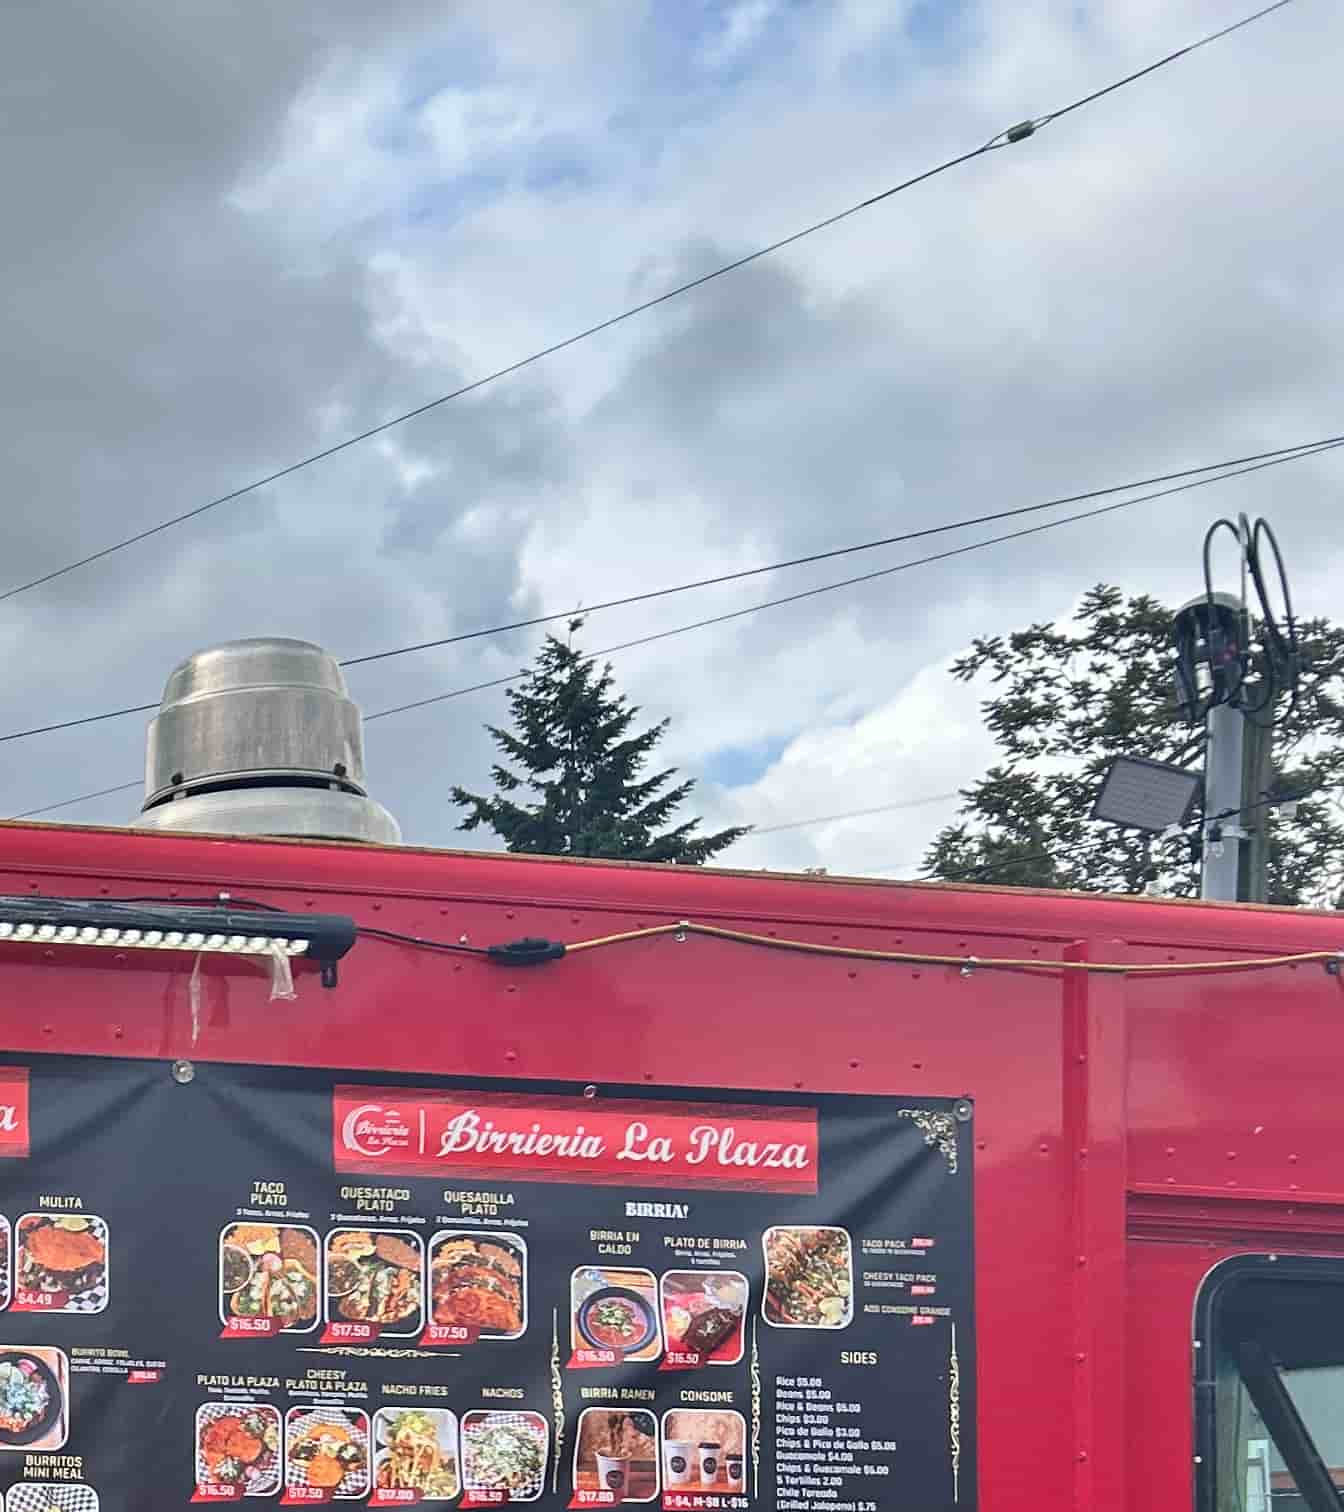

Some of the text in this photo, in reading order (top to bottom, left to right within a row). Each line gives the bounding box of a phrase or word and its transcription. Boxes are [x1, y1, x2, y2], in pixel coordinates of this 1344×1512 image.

[437, 1109, 809, 1168] Birrieria La Plaza
[254, 1182, 284, 1194] TACO
[341, 1187, 410, 1201] QUESATACO
[40, 1196, 82, 1209] MULITA
[250, 1193, 287, 1206] PLATO
[444, 1190, 514, 1205] QUESADILLA
[357, 1199, 393, 1211] PLATO
[462, 1204, 497, 1216] PLATO
[626, 1202, 688, 1218] BIRRIA!
[590, 1230, 639, 1242] BIRRIA EN
[664, 1237, 746, 1249] PLATO DE BIRRIA
[599, 1244, 631, 1255] CALDO
[18, 1293, 52, 1305] $4.49
[332, 1324, 369, 1337] $17.50
[430, 1326, 468, 1339] $17.50
[841, 1352, 877, 1364] SIDES
[307, 1368, 346, 1380] CHEESY
[198, 1374, 280, 1388] PLATO LA PLAZA
[286, 1380, 368, 1393] PLATO LA PLAZA
[776, 1376, 795, 1386] Rice
[382, 1384, 448, 1397] NACHO FRIES
[482, 1388, 523, 1399] NACHOS
[581, 1387, 655, 1400] BIRRIA RAMEN
[681, 1390, 733, 1402] CONSOME
[776, 1389, 804, 1399] Beans
[776, 1401, 795, 1410] Rice
[776, 1414, 800, 1424] Chips
[776, 1426, 795, 1436] Pico
[797, 1427, 808, 1436] de
[776, 1438, 800, 1448] Chips
[813, 1439, 831, 1449] Pico
[834, 1440, 844, 1449] de
[846, 1440, 869, 1450] Gallo
[26, 1455, 82, 1467] BURRITOS
[24, 1467, 84, 1479] MINI MEAL
[776, 1463, 801, 1473] Chips
[813, 1464, 862, 1474] Guacamole
[785, 1475, 821, 1485] Tortillas
[288, 1488, 323, 1499] $17.50
[776, 1488, 800, 1497] Chile
